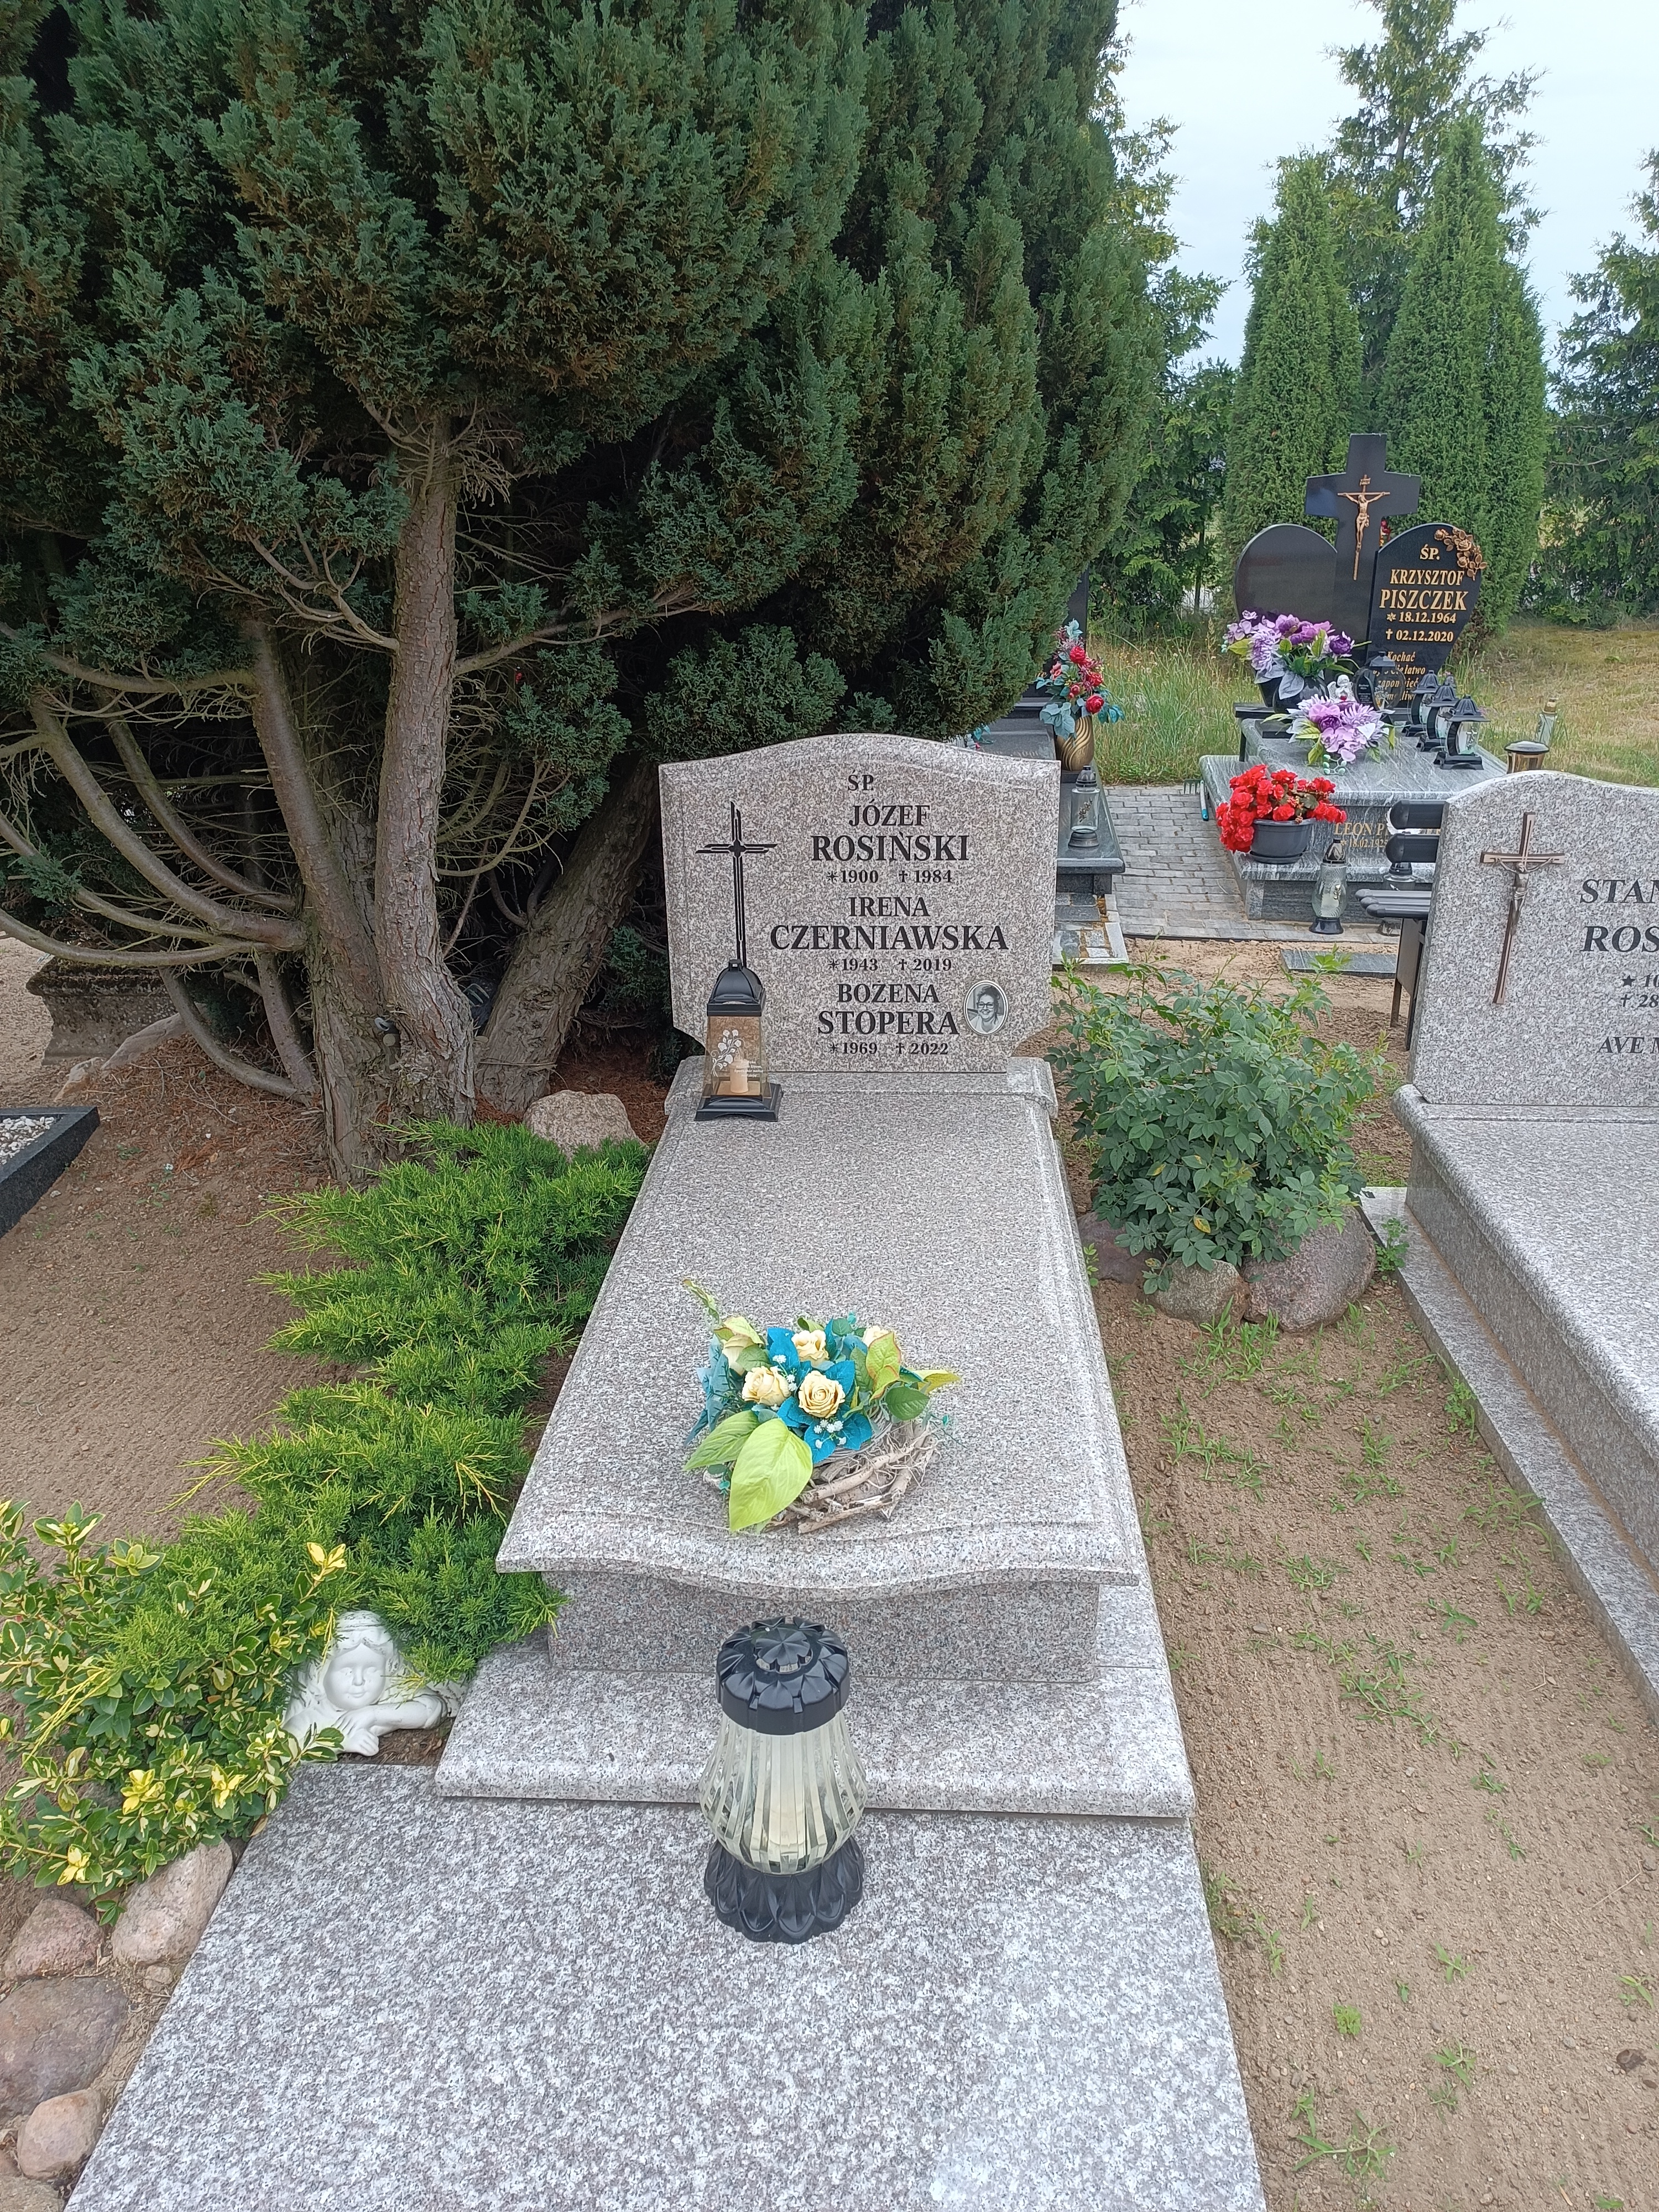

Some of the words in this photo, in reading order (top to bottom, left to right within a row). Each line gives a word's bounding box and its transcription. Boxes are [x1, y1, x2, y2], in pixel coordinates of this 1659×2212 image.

[1420, 544, 1440, 560] ŚP.
[1390, 569, 1464, 586] KRZYSZTOF
[1380, 589, 1468, 611] PISZCZEK
[1399, 612, 1457, 624] 18.12.1964
[1396, 630, 1453, 642] 02.12.2020
[1387, 651, 1416, 661] Kochać
[849, 799, 930, 827] JÓZEF
[1333, 822, 1373, 835] LEON
[811, 831, 969, 862] ROSIŃSKI
[841, 870, 879, 883] 1900
[915, 869, 952, 883] 1984
[848, 896, 930, 917] IRENA
[771, 925, 1008, 950] CZERNIAWSKA
[842, 958, 878, 971] 1943
[912, 958, 952, 971] 2019
[838, 981, 940, 1003] BOŻENA
[818, 1011, 959, 1035] STOPERA
[843, 1042, 877, 1055] 1969
[910, 1042, 948, 1056] 2022
[1598, 1036, 1644, 1053] AVE
